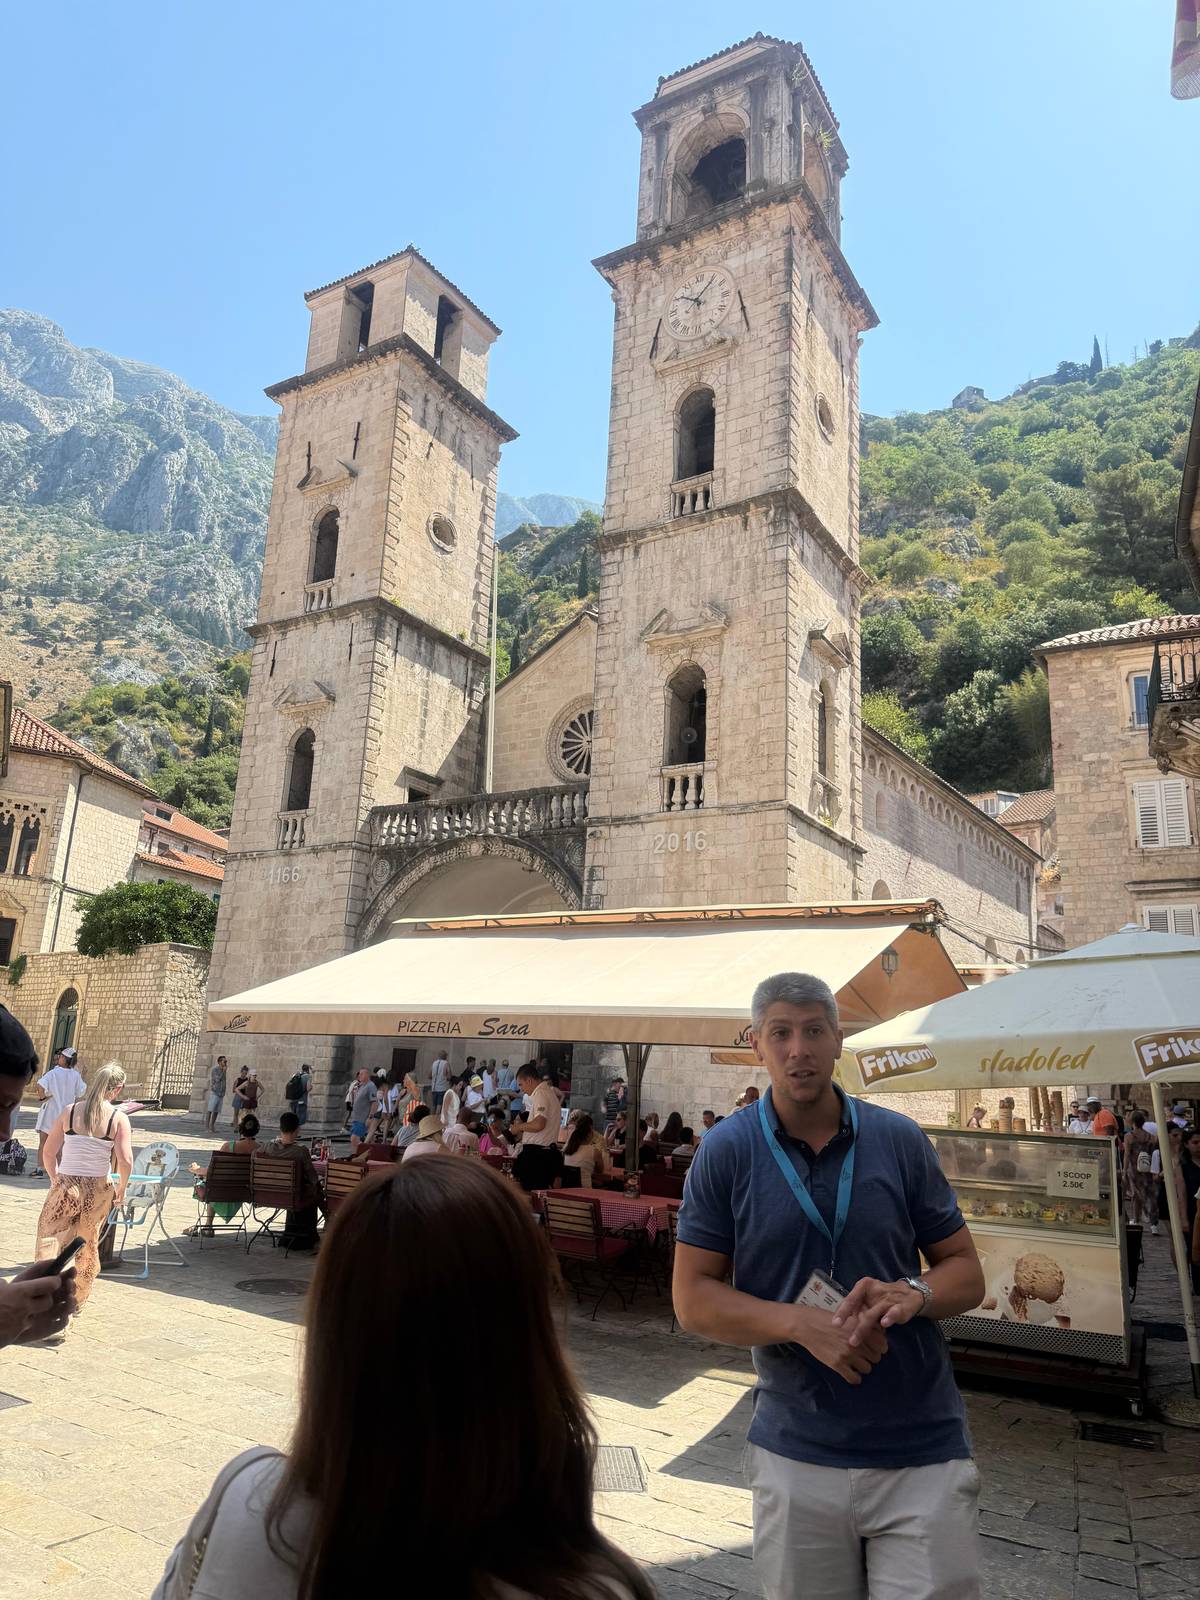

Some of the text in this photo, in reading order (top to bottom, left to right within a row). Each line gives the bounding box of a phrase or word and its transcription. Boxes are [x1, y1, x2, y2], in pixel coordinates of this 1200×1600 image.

[653, 830, 707, 855] 2016
[269, 865, 300, 884] 1166
[397, 1017, 530, 1036] PIZZERIA Sara
[861, 1048, 934, 1078] Frikom
[978, 1044, 1096, 1073] sladoled
[1063, 1171, 1092, 1180] SCOOP
[1063, 1180, 1085, 1189] 2.50€
